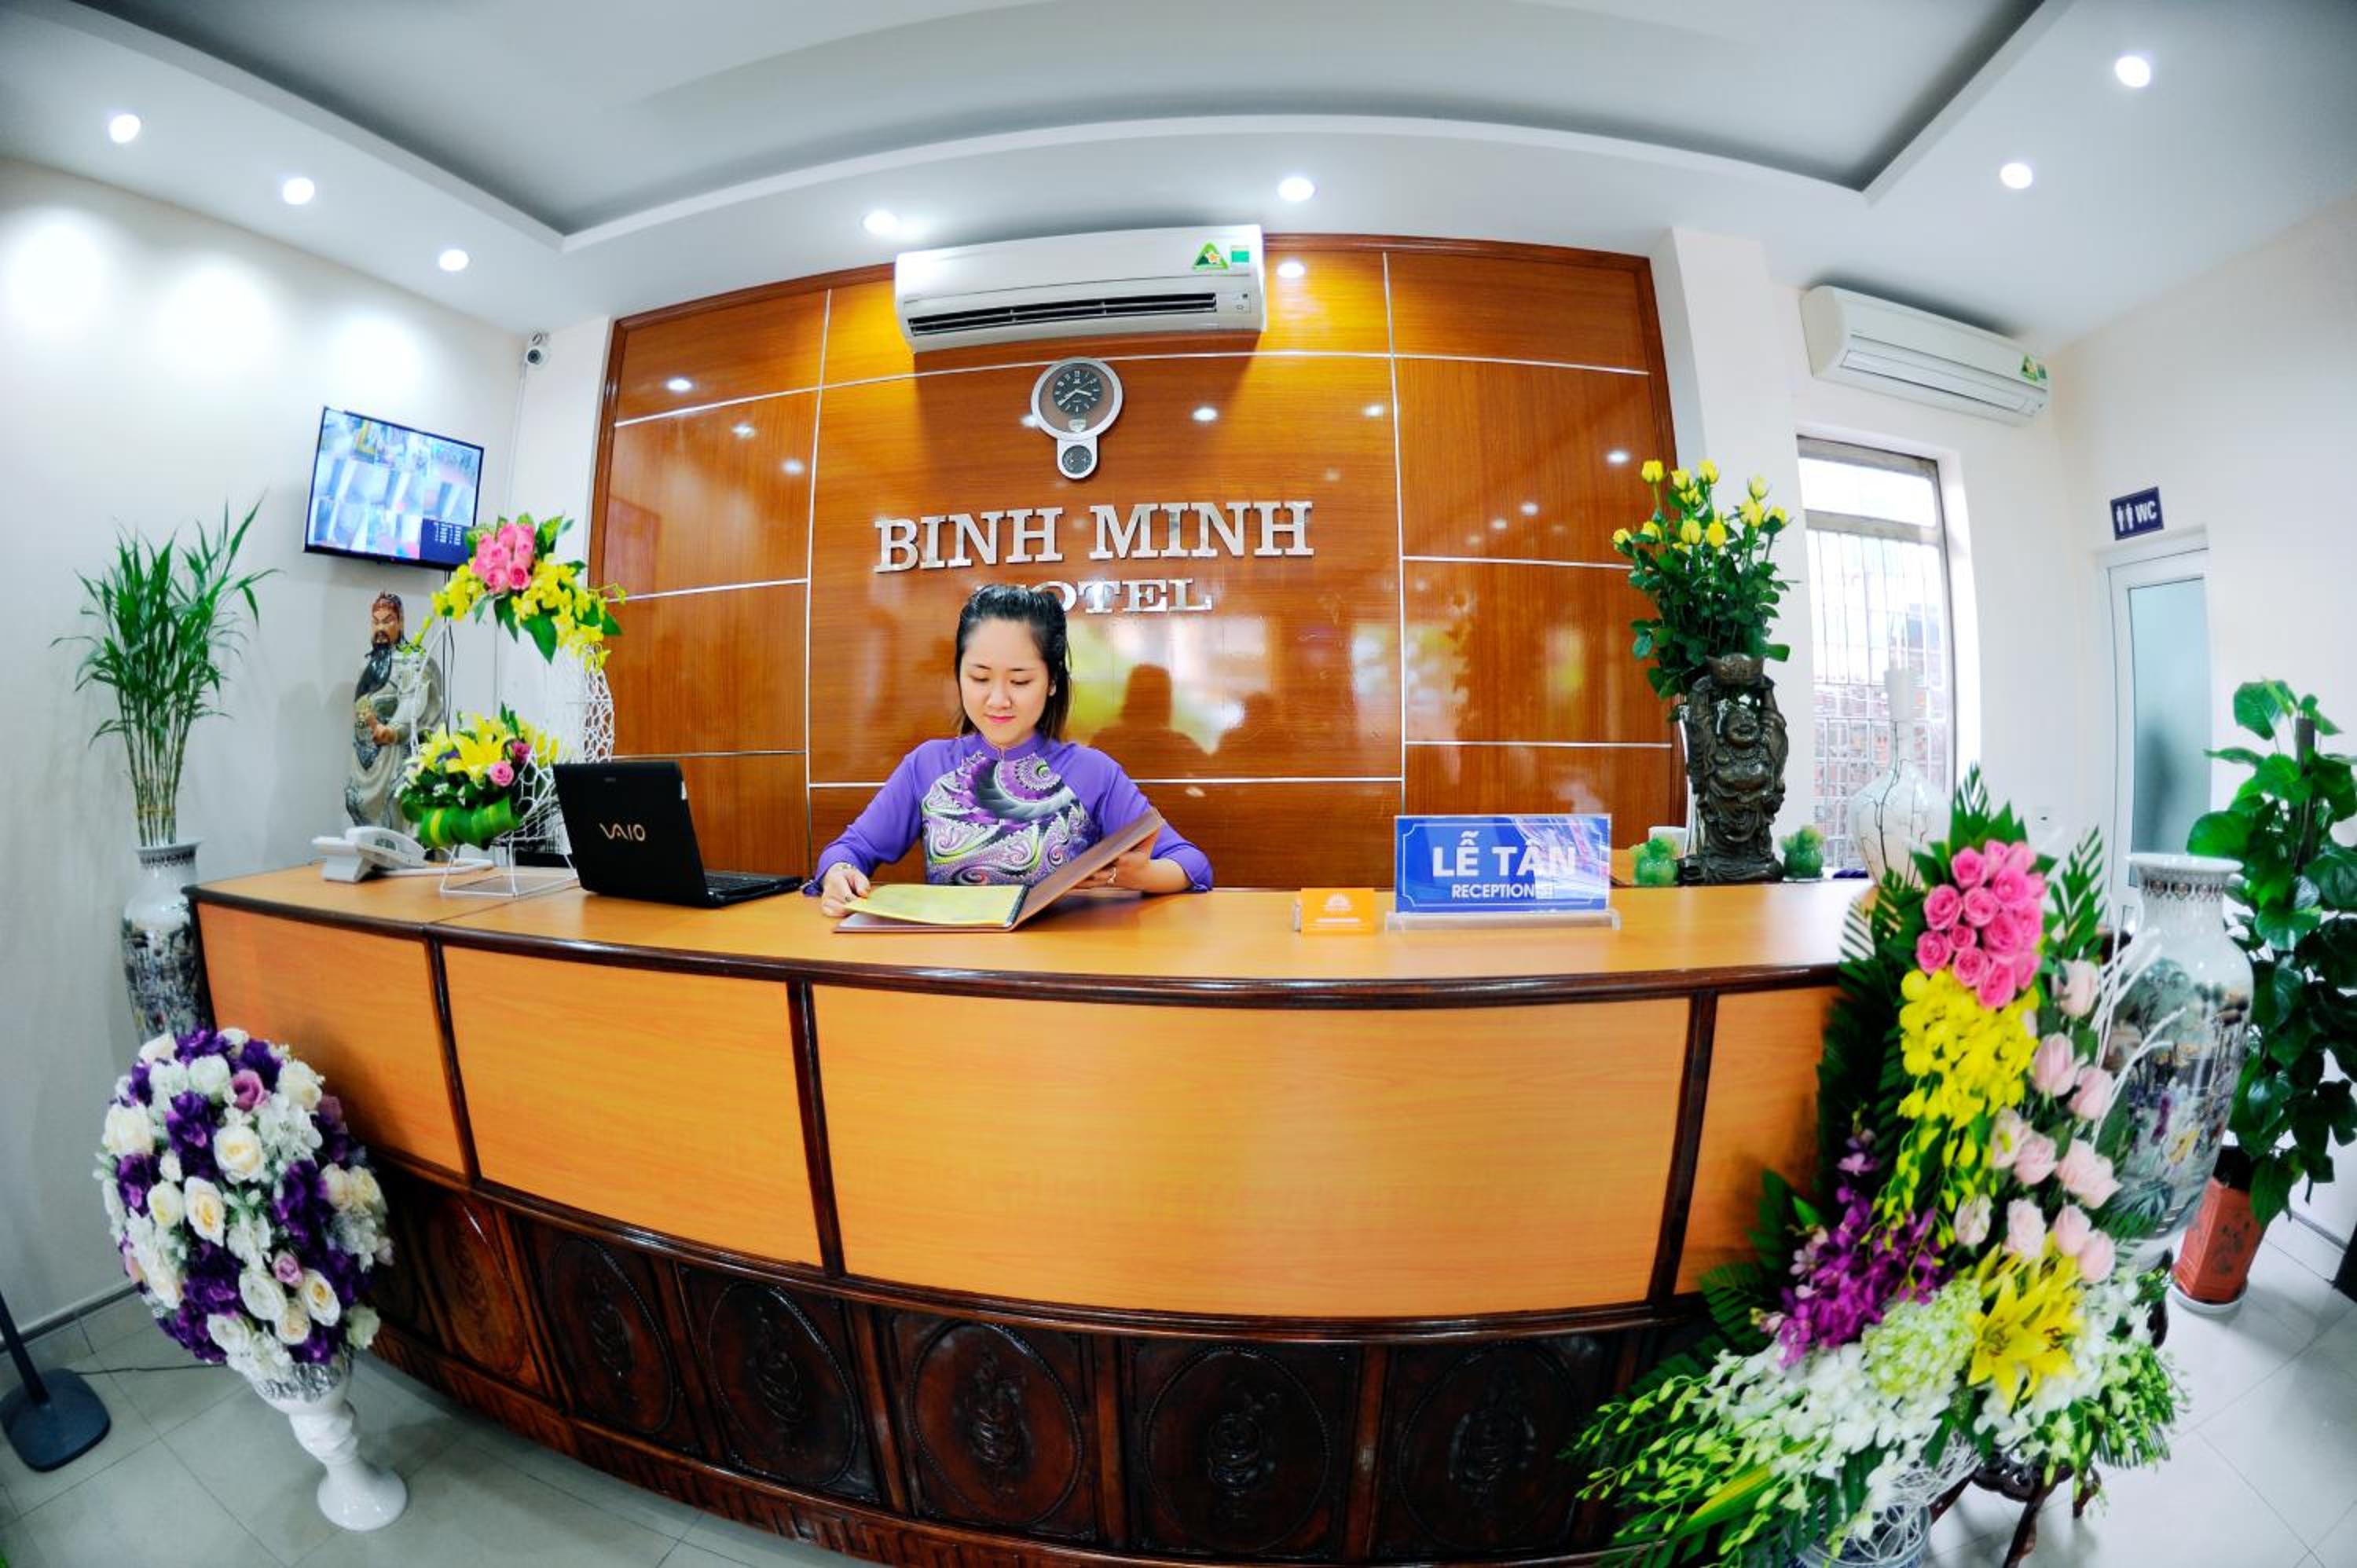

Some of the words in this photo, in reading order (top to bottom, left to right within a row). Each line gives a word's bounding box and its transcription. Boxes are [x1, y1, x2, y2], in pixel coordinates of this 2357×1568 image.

[2135, 500, 2157, 523] WC
[874, 507, 1063, 573] BINH
[1090, 501, 1314, 559] MINH
[977, 578, 1212, 614] OTEL
[599, 823, 646, 841] VAIO
[1432, 830, 1479, 877] LỄ
[1491, 838, 1576, 877] TÂN
[1451, 883, 1554, 899] RECEPTION
